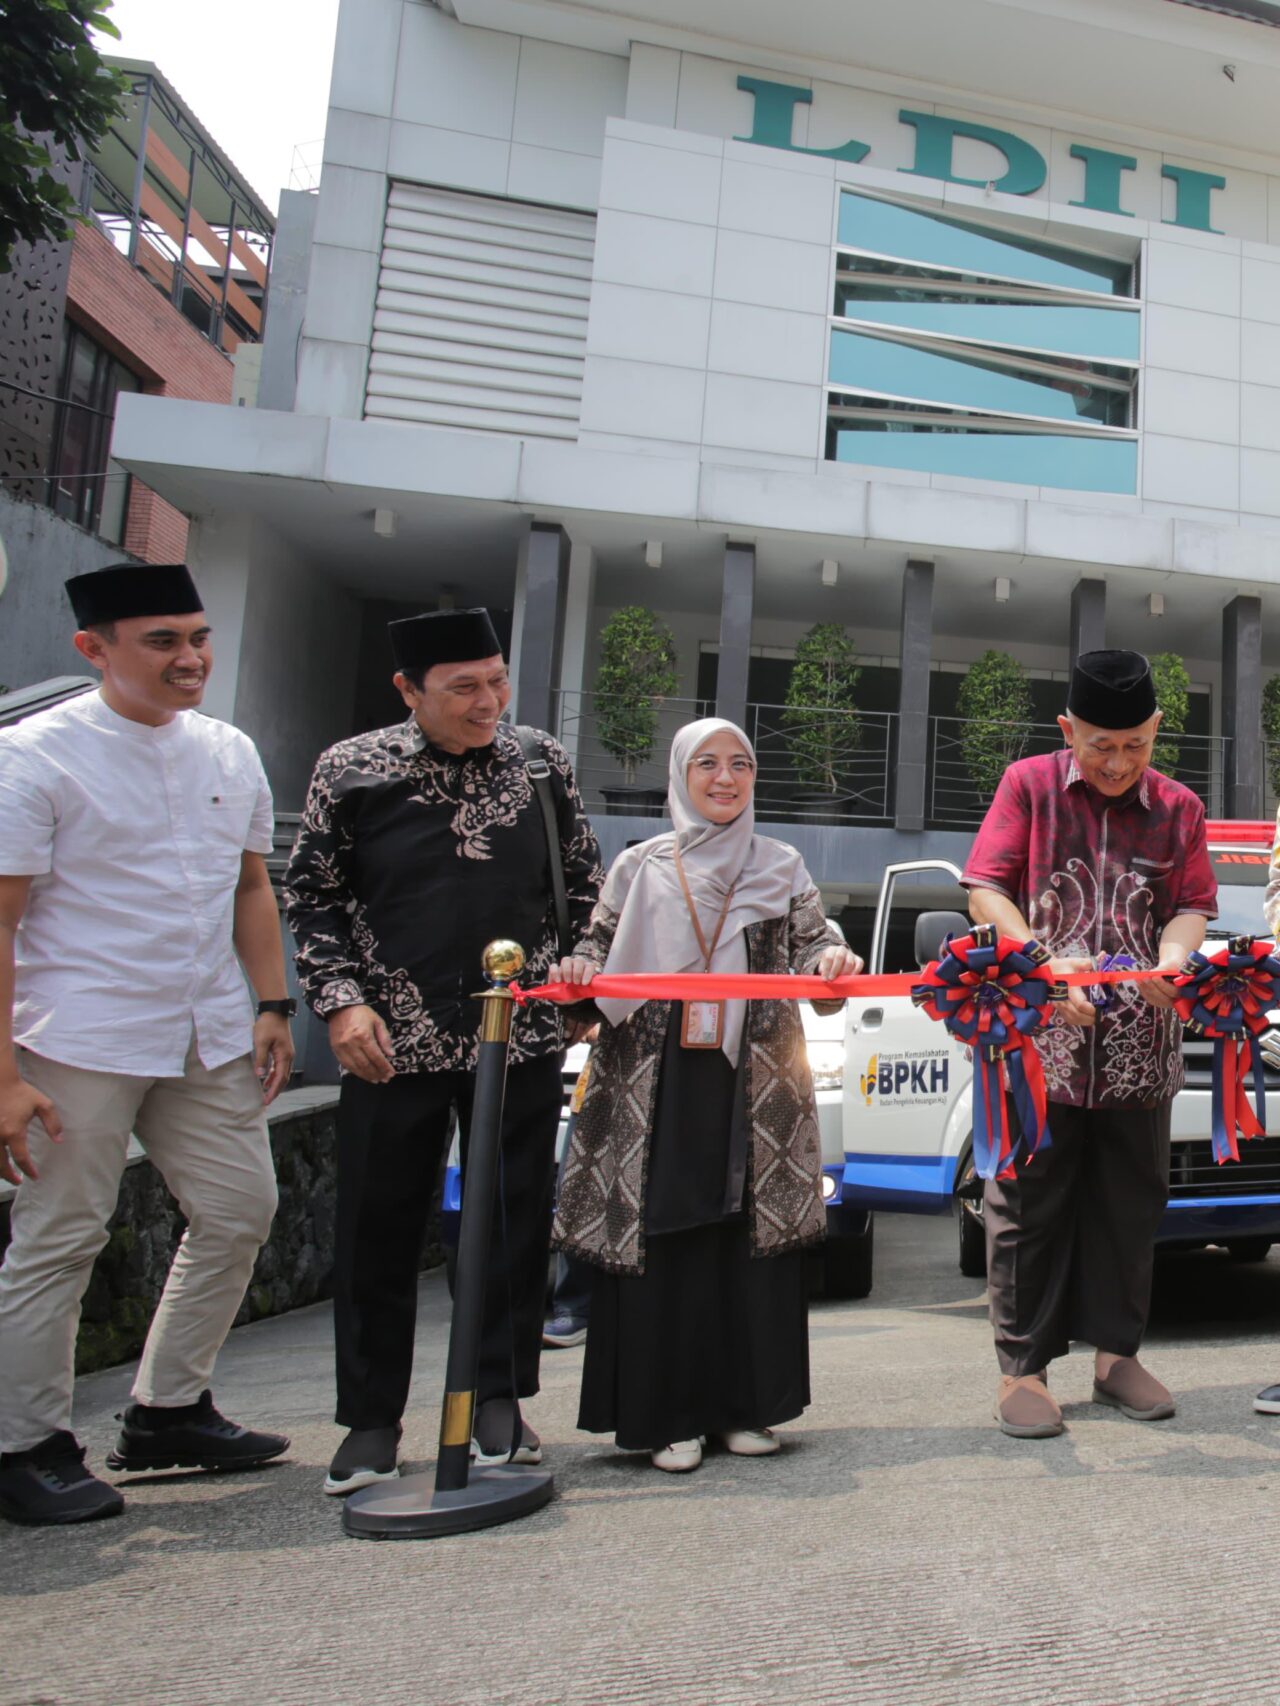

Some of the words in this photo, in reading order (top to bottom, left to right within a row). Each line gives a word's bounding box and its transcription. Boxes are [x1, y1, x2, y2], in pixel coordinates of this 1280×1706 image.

[732, 74, 1227, 236] LDII
[879, 1053, 903, 1061] Program
[905, 1050, 949, 1058] Kemaslahatan
[878, 1058, 949, 1095] BPKH
